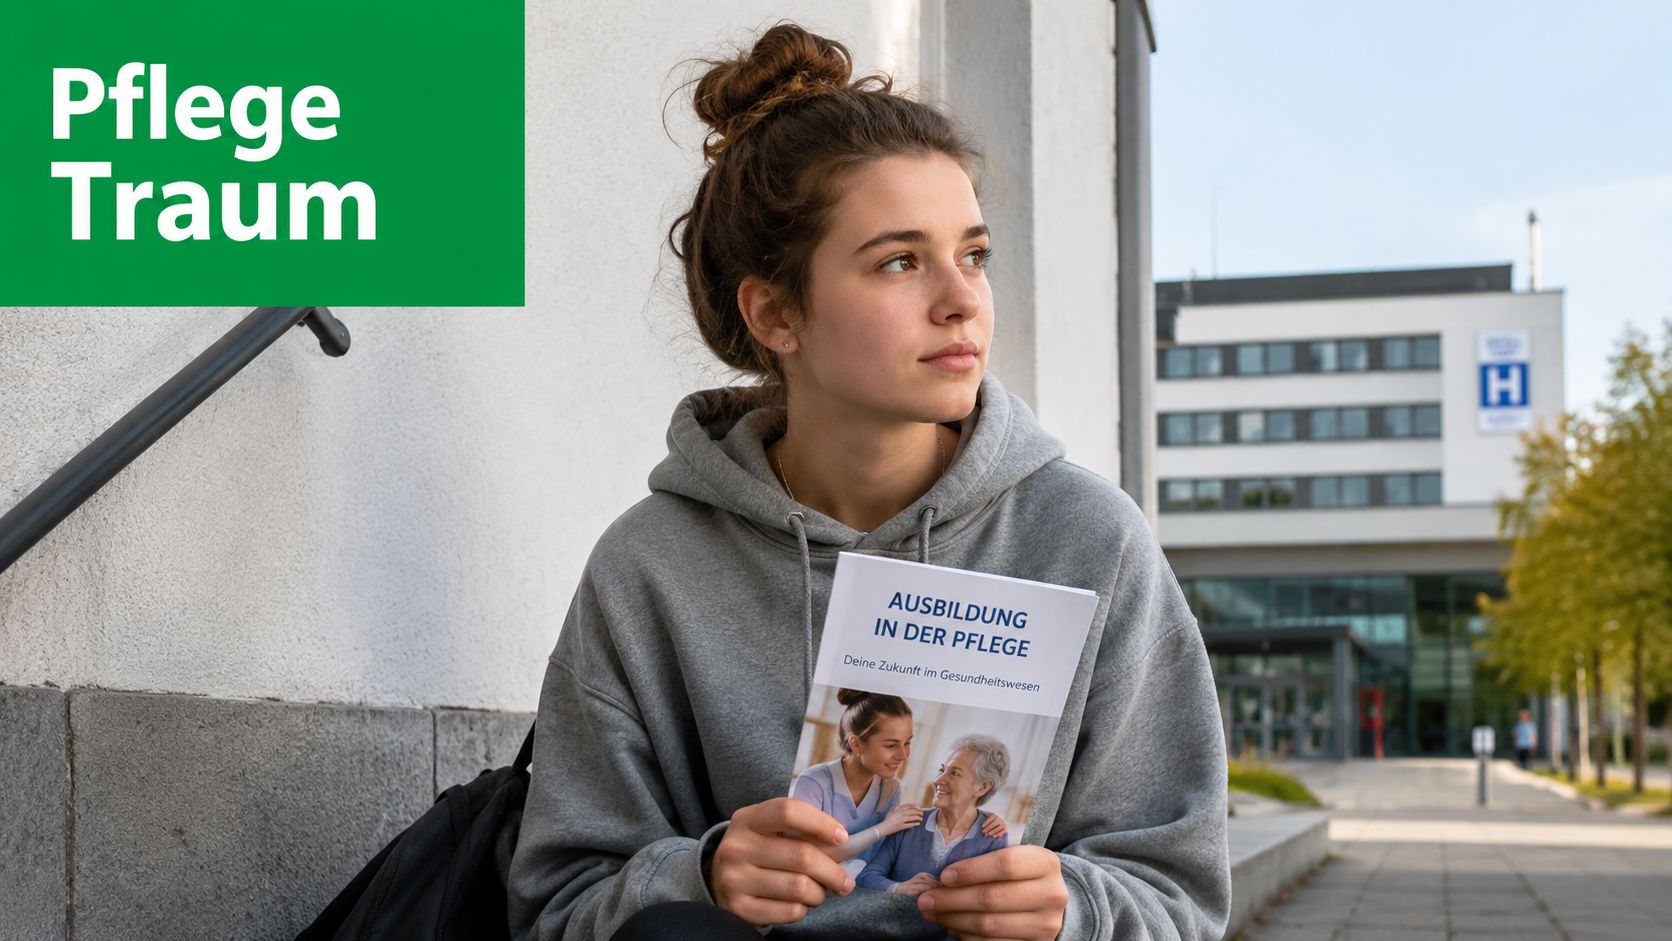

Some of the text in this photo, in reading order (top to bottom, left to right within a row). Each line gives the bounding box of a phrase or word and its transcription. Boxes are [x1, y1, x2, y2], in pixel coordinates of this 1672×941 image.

[1487, 364, 1521, 405] H
[888, 591, 1028, 629] AUSBILDUNG
[874, 617, 1031, 658] IN DER PFLEGE
[843, 654, 1040, 693] Deine Zukunft im Gesundheitswesen
